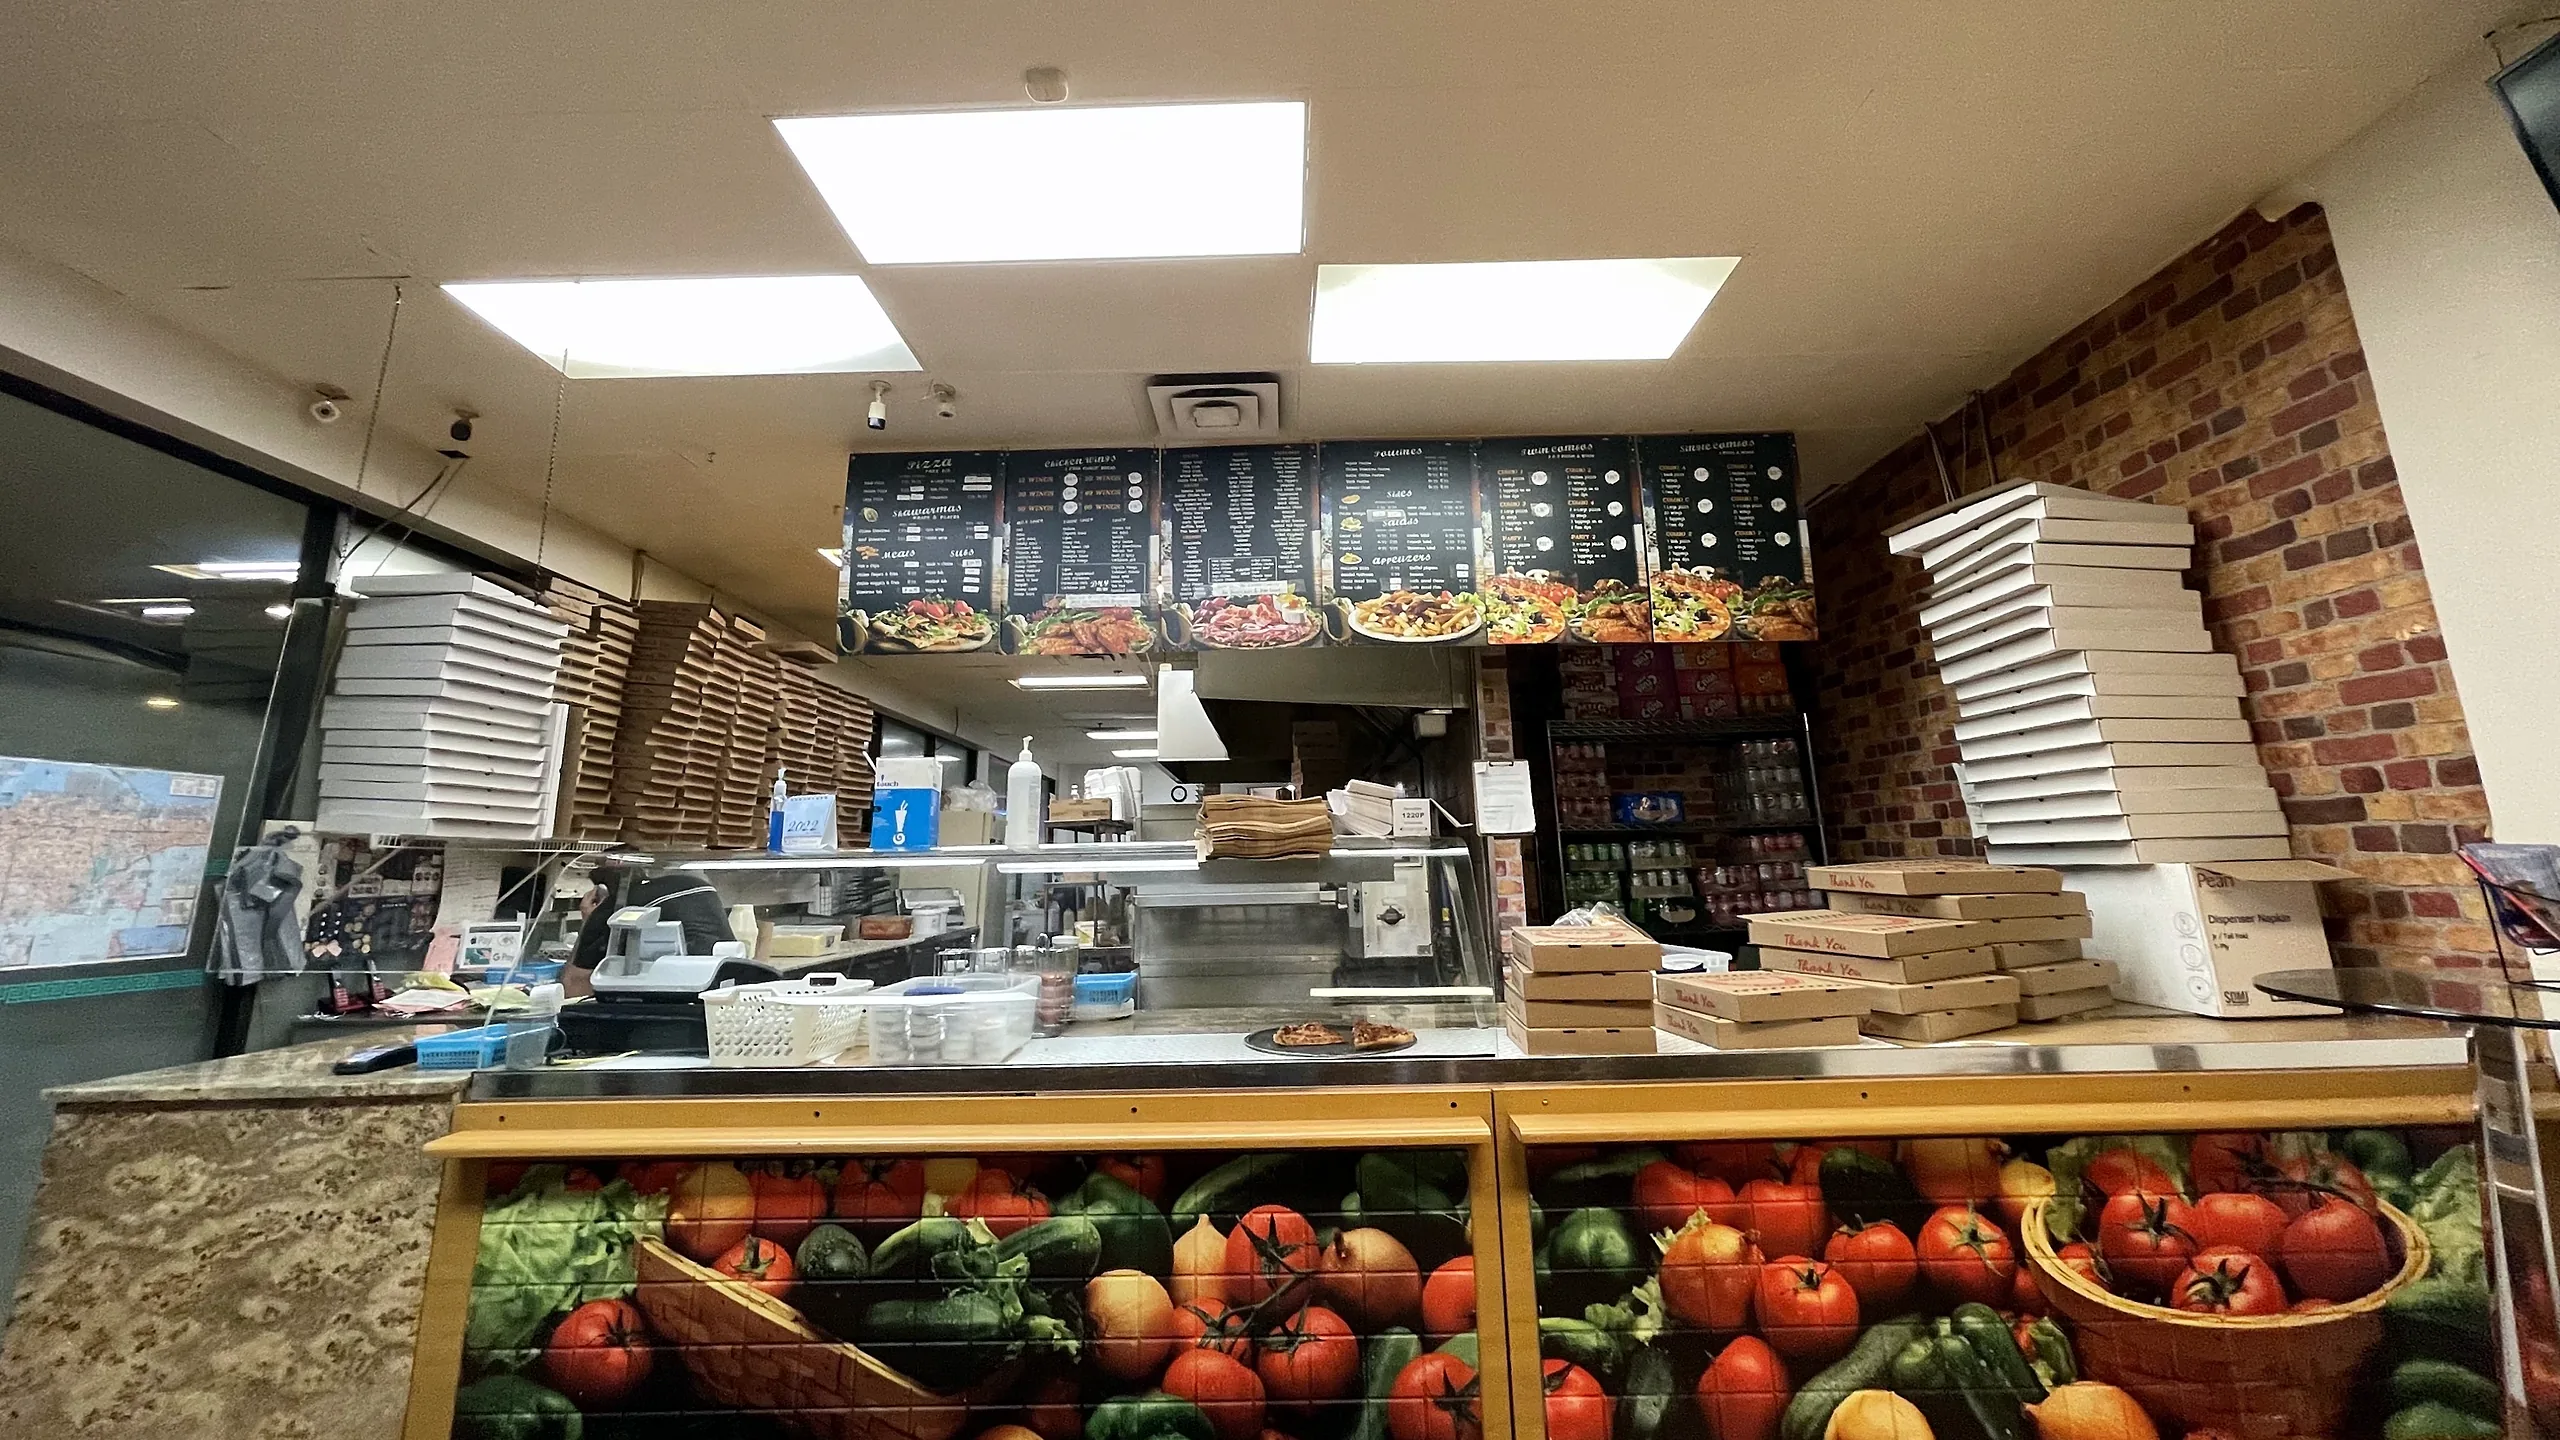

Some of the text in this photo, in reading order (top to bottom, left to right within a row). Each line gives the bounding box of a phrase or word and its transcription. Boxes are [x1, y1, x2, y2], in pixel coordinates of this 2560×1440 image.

[1373, 447, 1423, 458] Poutines
[1520, 447, 1550, 457] Twin
[1551, 443, 1594, 454] Combos
[907, 457, 952, 470] Pizza
[1044, 458, 1083, 468] Chicken
[1085, 455, 1117, 464] Wings
[1386, 489, 1413, 498] Sides
[892, 504, 962, 518] Shawarmas
[1382, 517, 1419, 527] Salads
[881, 549, 916, 560] Meals
[950, 548, 975, 558] Subs
[1372, 553, 1432, 565] Appetizers
[787, 820, 819, 832] 2022
[1829, 874, 1876, 889] Thank You
[1859, 896, 1921, 913] Thank You
[2208, 914, 2255, 925] Dispenser
[1784, 934, 1847, 951] Thank You
[1797, 959, 1862, 977] Thank You
[1675, 989, 1699, 1004] Thank
[1860, 1017, 1885, 1033] You
